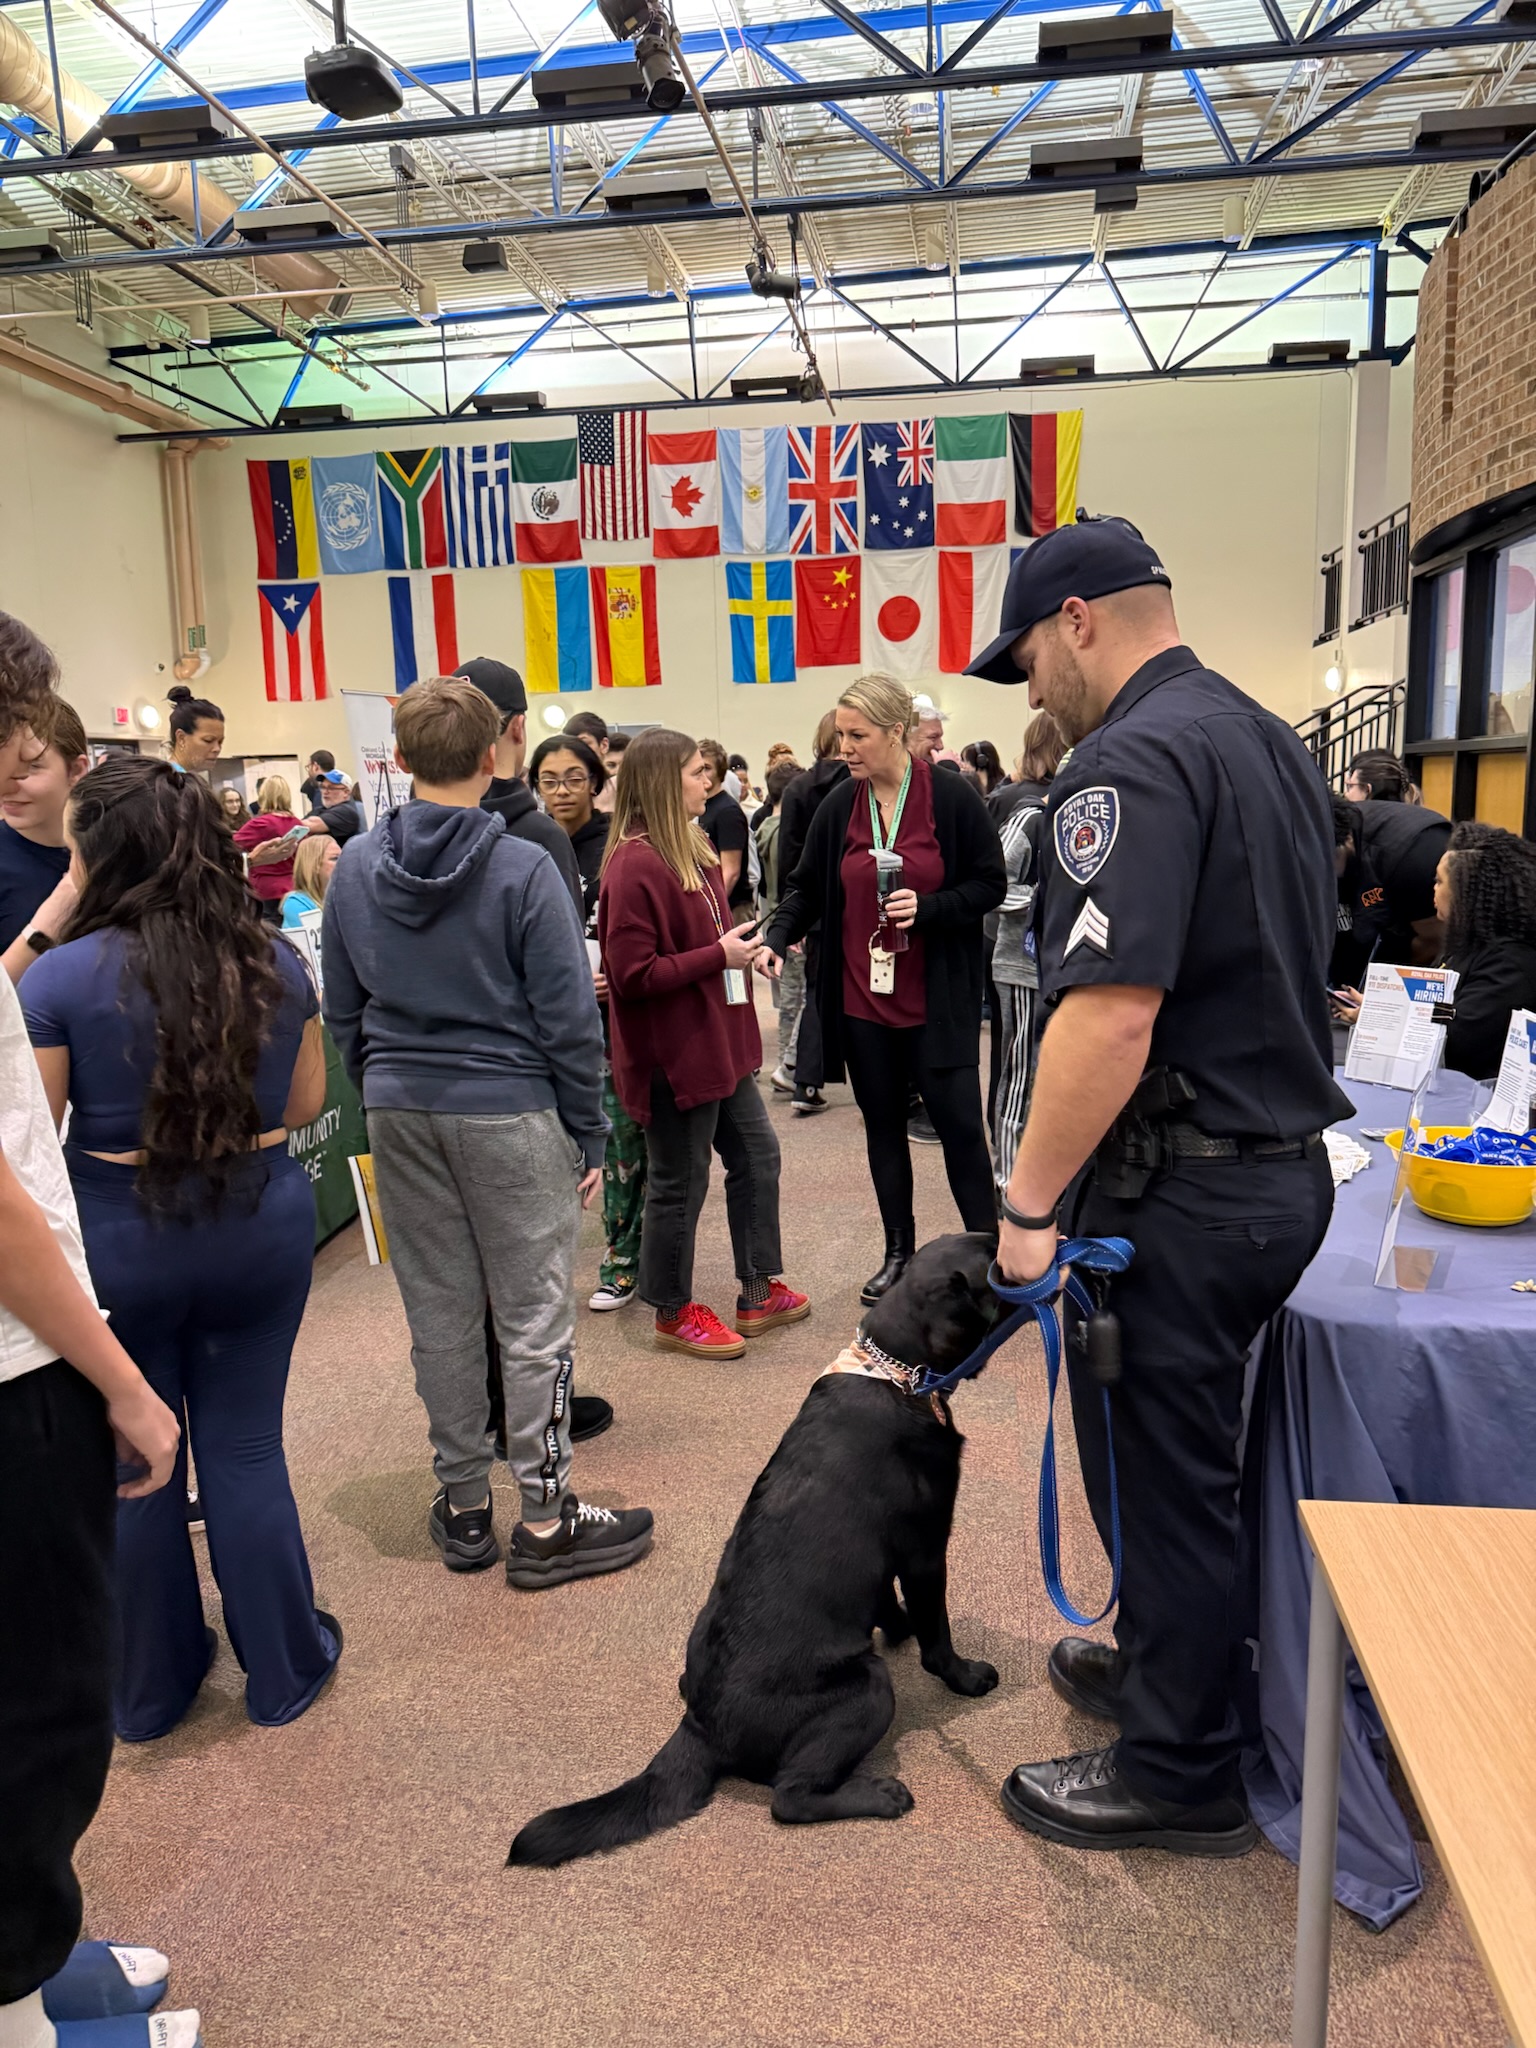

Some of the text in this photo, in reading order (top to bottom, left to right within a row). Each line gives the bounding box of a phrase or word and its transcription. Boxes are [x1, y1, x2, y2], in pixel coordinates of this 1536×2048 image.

[1061, 803, 1111, 838] POLICE
[1063, 793, 1105, 818] ROYAL OAK
[1413, 989, 1444, 1003] HIRING
[1426, 981, 1445, 991] WE'RE
[288, 1105, 341, 1158] MUNITY
[553, 1360, 571, 1419] HOLLISTER
